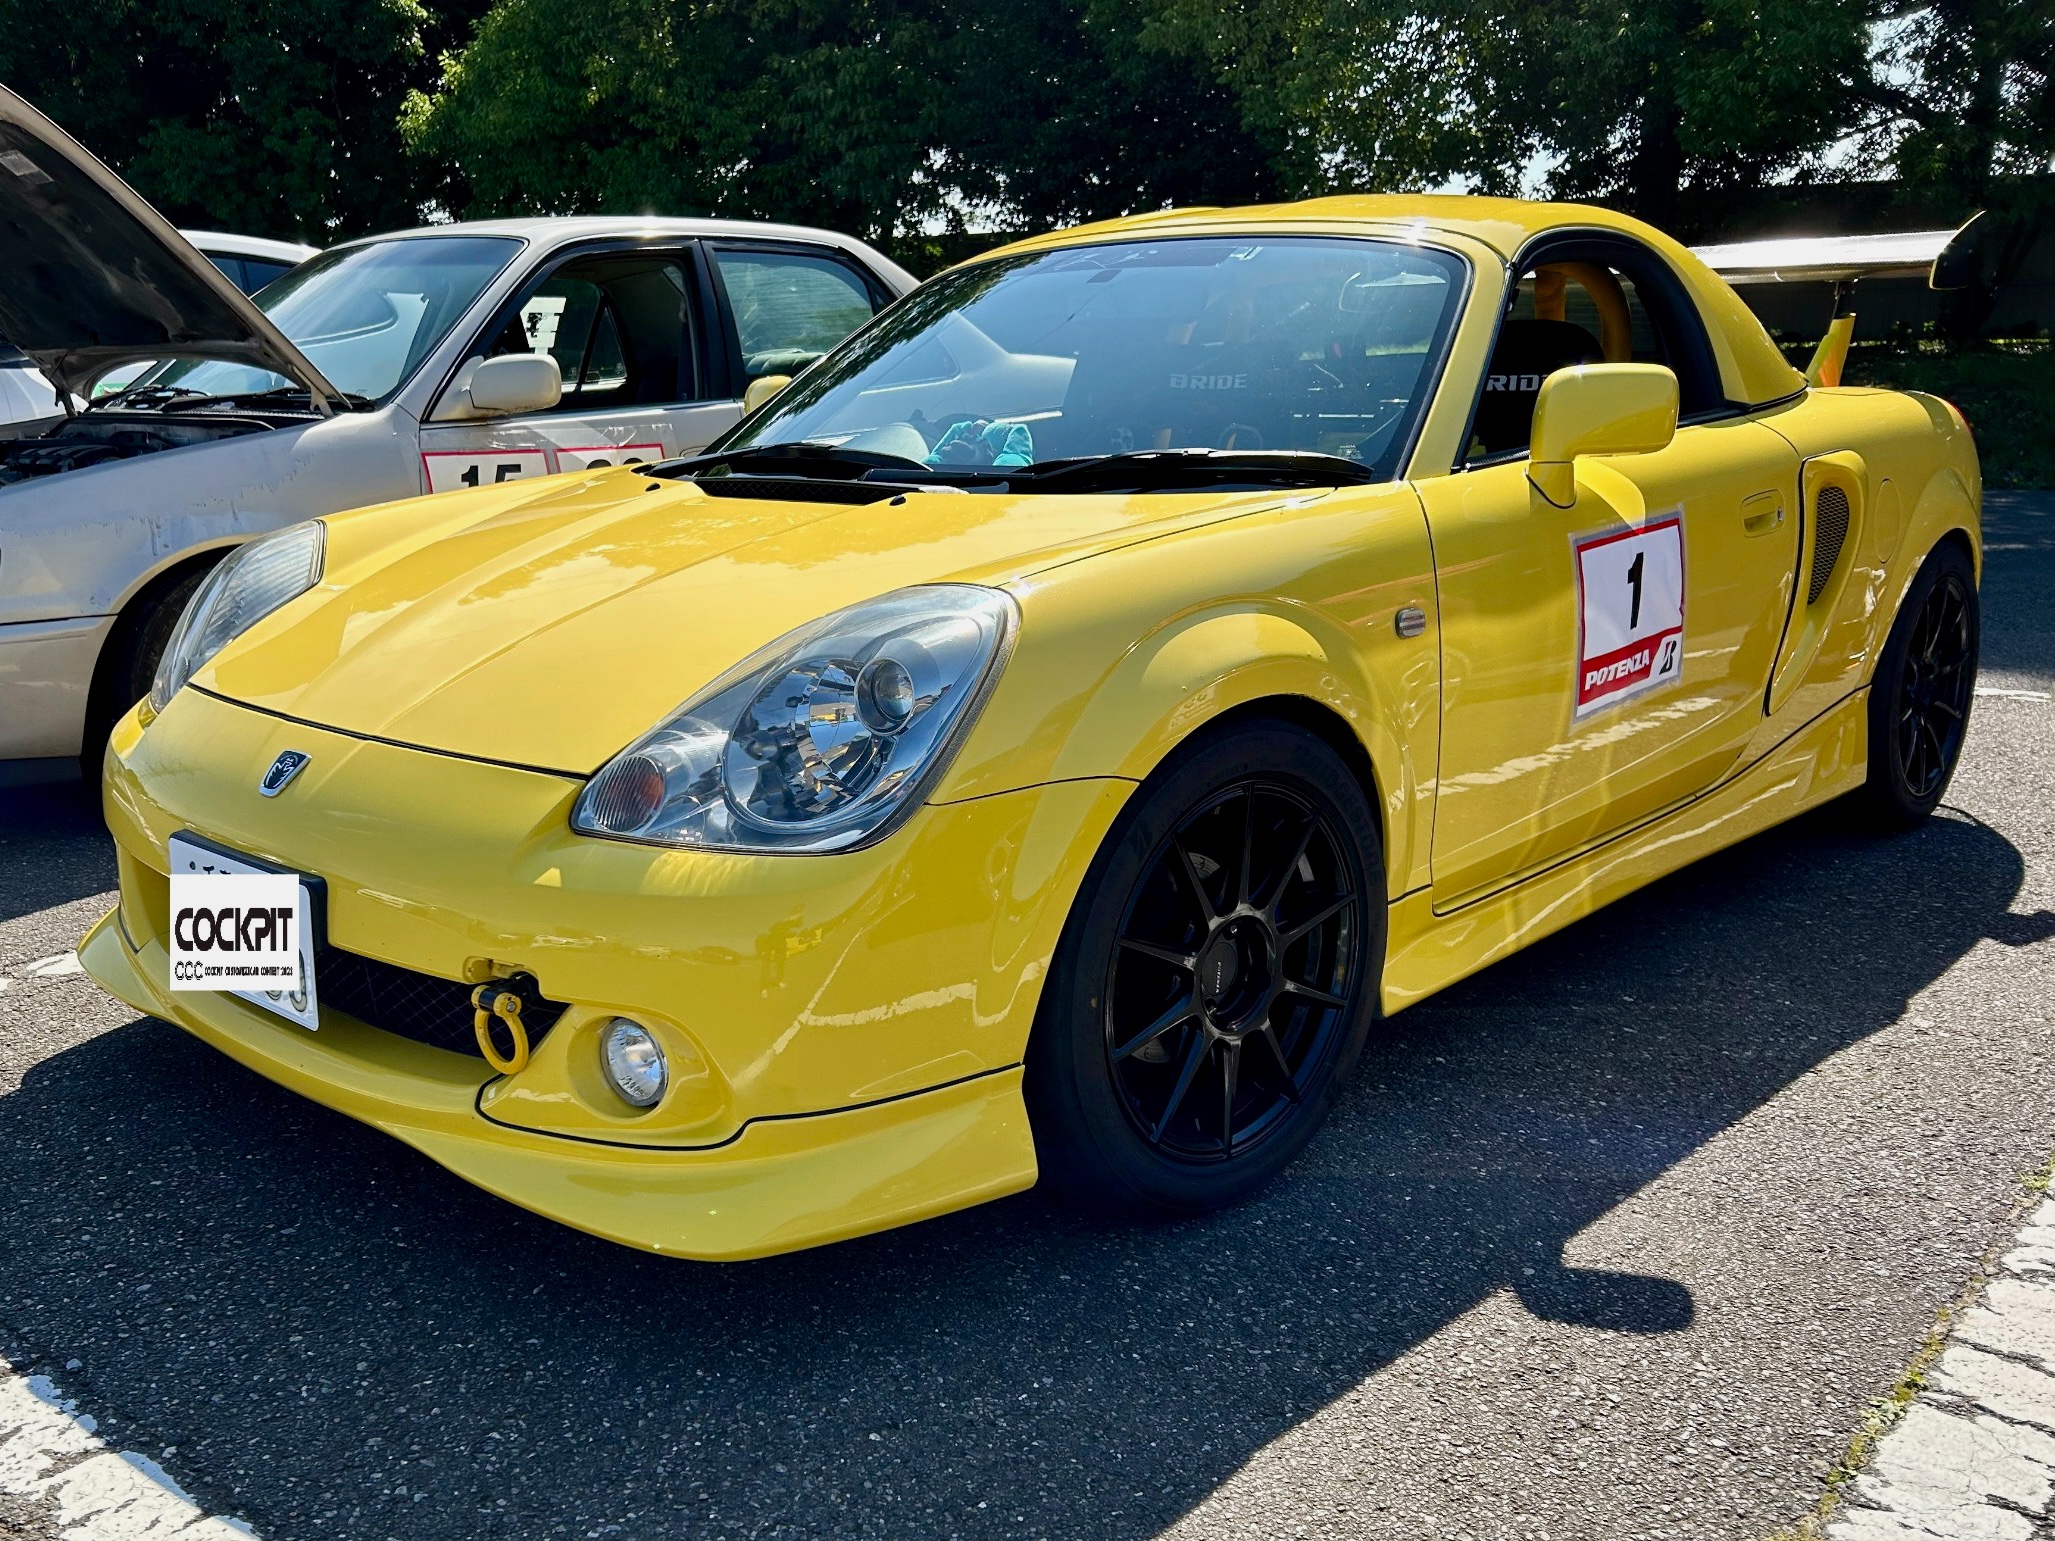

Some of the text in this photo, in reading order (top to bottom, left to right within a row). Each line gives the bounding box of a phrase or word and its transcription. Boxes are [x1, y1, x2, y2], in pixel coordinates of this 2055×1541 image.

[1169, 374, 1247, 390] BRIDE
[1486, 374, 1549, 391] RID
[1627, 551, 1644, 630] 1
[1584, 648, 1650, 691] POTENZA
